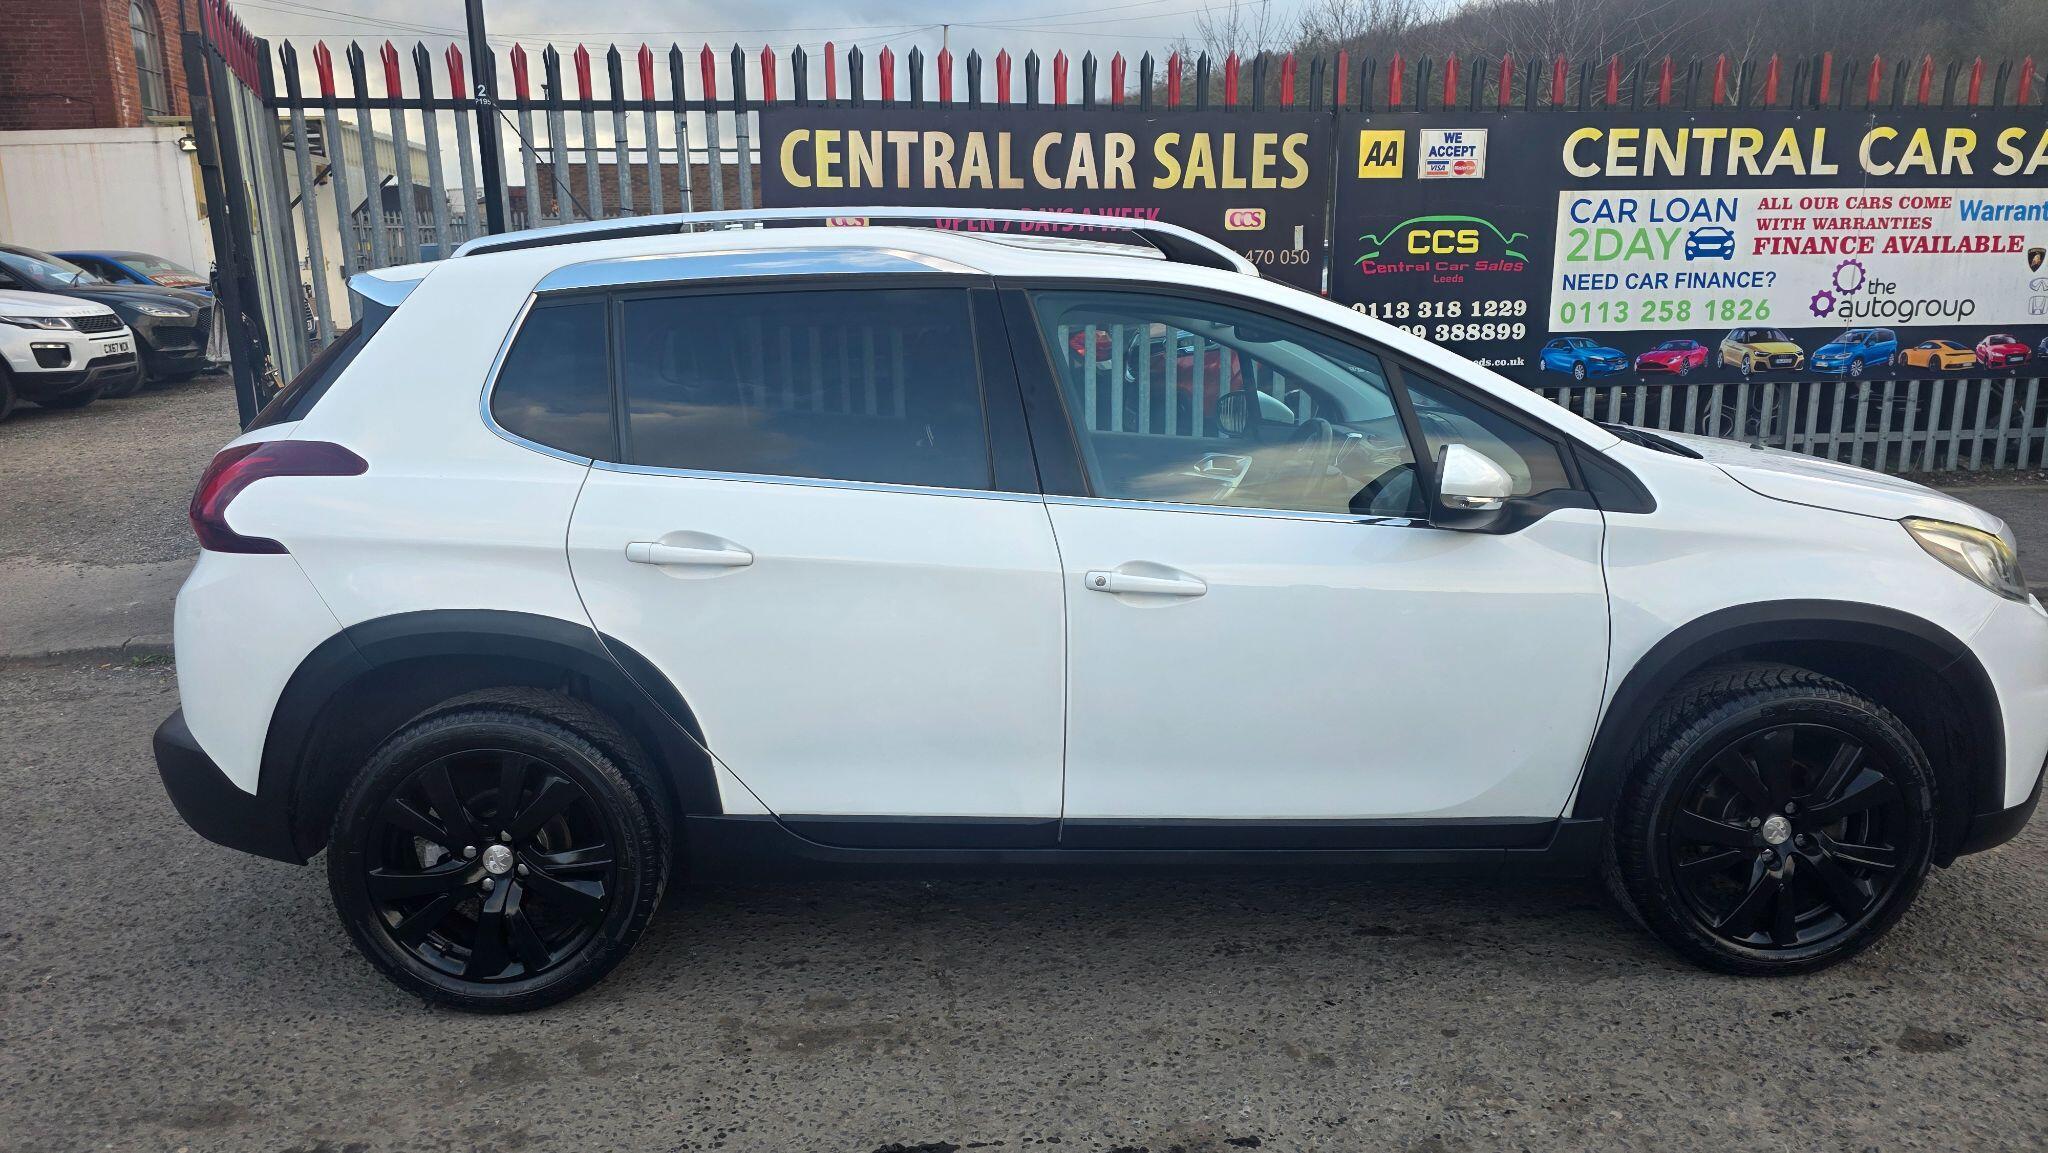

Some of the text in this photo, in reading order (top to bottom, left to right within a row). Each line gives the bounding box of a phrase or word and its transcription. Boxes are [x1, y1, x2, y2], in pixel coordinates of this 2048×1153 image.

[477, 84, 486, 97] 2
[1444, 132, 1463, 144] WE
[779, 128, 1309, 190] CENTRAL CAR SALES
[1363, 140, 1398, 167] AA
[1428, 145, 1477, 158] ACCEPT
[1562, 127, 1839, 178] CENTRAL
[1858, 126, 1977, 176] CAR
[1430, 164, 1446, 172] VISA
[1570, 197, 1738, 224] CAR LOAN
[1757, 196, 1952, 210] ALL OUR CARS COME
[1229, 211, 1262, 227] CCS
[1756, 216, 1933, 231] WITH WARRANTIES
[1407, 229, 1480, 254] CCS
[1566, 227, 1682, 262] 2DAY
[1752, 235, 2025, 256] FINANCE AVAILABLE
[1244, 249, 1310, 265] 470 050
[1361, 259, 1524, 275] Central Car Sales
[1433, 274, 1464, 283] Leeds
[1562, 271, 1777, 291] NEED CAR FINANCE?
[1868, 278, 1897, 295] the
[1351, 299, 1527, 319] 0113 318 1229
[1560, 298, 1771, 324] 0113 258 1826
[1838, 298, 1976, 323] autogroup
[1434, 322, 1527, 342] 388899
